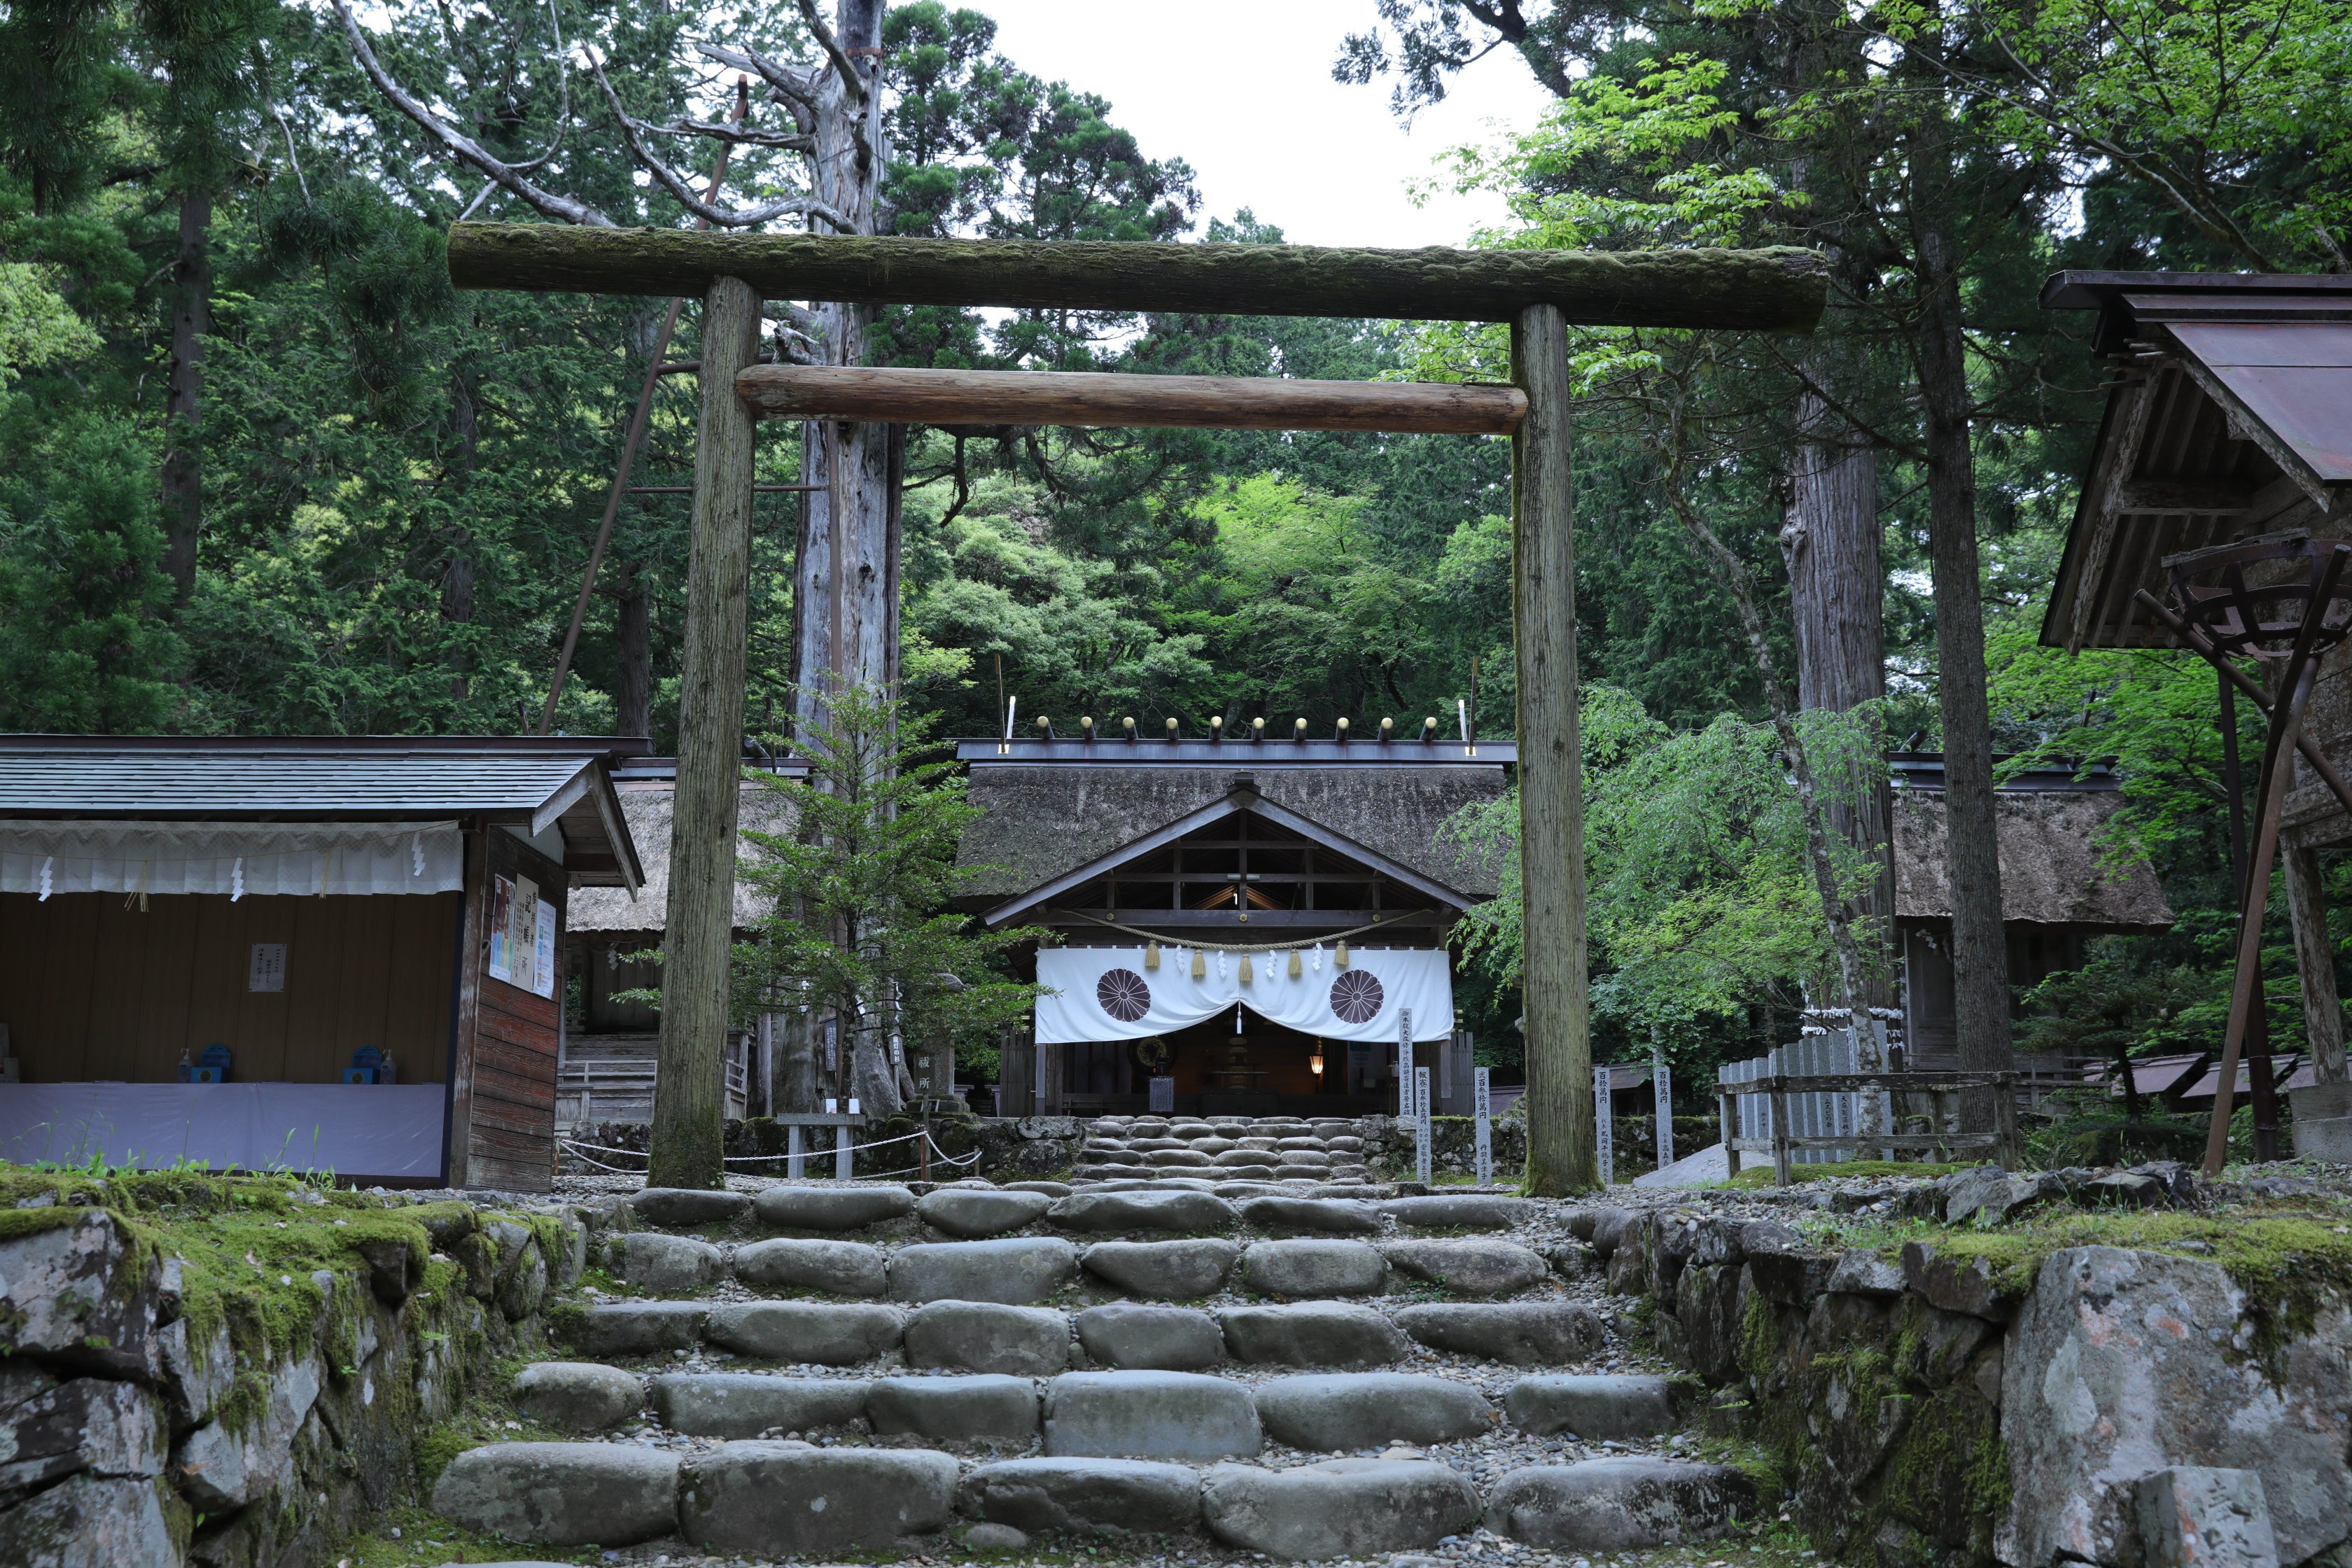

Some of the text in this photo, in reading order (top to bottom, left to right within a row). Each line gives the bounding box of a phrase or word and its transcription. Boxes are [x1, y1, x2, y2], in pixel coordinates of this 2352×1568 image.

[521, 893, 531, 976] 記帳所
[918, 1056, 930, 1089] 祓所
[1599, 1072, 1607, 1103] 百拾萬円
[1659, 1071, 1667, 1103] 百拾萬円
[1480, 1144, 1488, 1180] 丹羽美津子
